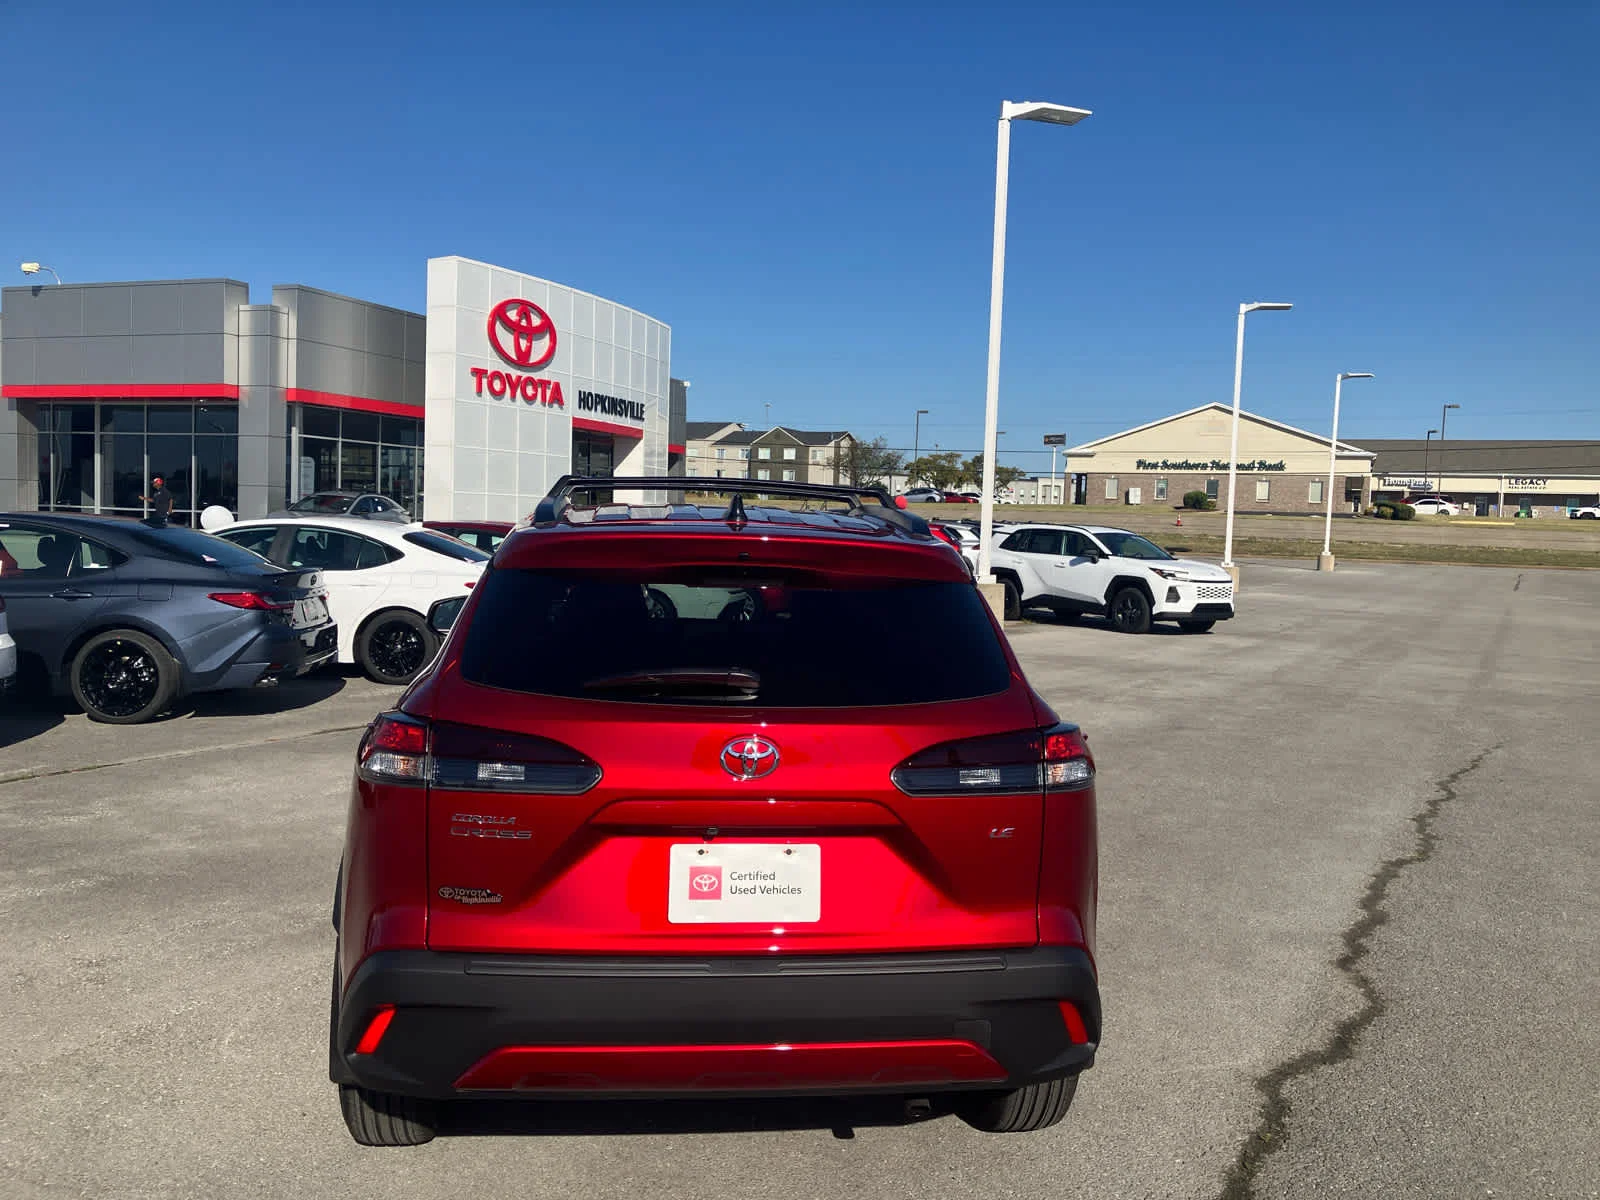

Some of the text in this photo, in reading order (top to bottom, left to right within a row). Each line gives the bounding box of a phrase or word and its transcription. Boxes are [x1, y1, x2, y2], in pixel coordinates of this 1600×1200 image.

[470, 367, 565, 407] TOYOTA
[578, 390, 645, 422] HOPKINSVILLE
[1161, 459, 1208, 470] Southern
[1257, 459, 1286, 471] Bank
[1508, 478, 1548, 486] LEGACY
[452, 813, 517, 825] COROLLA
[450, 827, 533, 839] CROSS
[989, 827, 1016, 839] LE
[730, 871, 776, 881] Certified
[454, 888, 488, 897] TOYOTA
[730, 884, 802, 895] Used Vehicles
